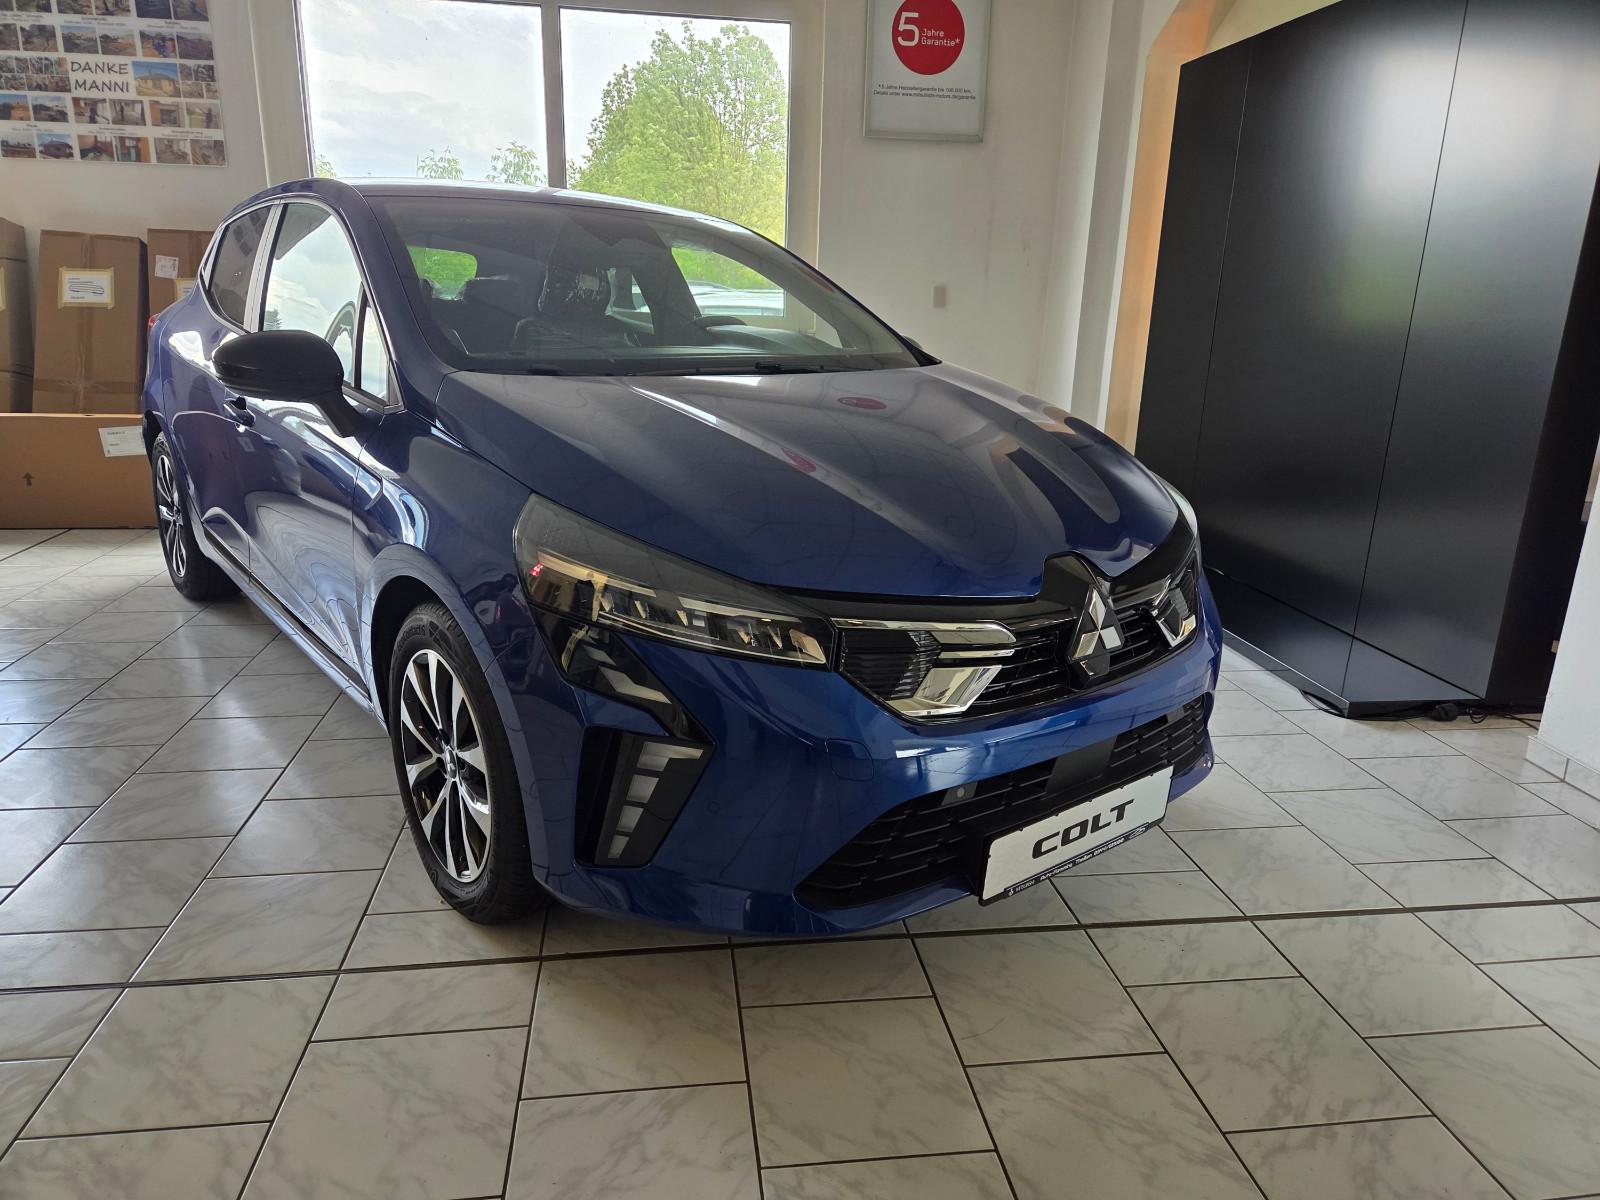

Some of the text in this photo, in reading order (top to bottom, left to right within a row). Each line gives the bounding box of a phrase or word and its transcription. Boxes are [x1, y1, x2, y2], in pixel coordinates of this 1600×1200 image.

[898, 12, 920, 47] 5
[922, 29, 945, 37] Jahre
[70, 60, 129, 75] DANKE
[74, 79, 130, 93] MANNI
[1032, 798, 1135, 860] COLT
